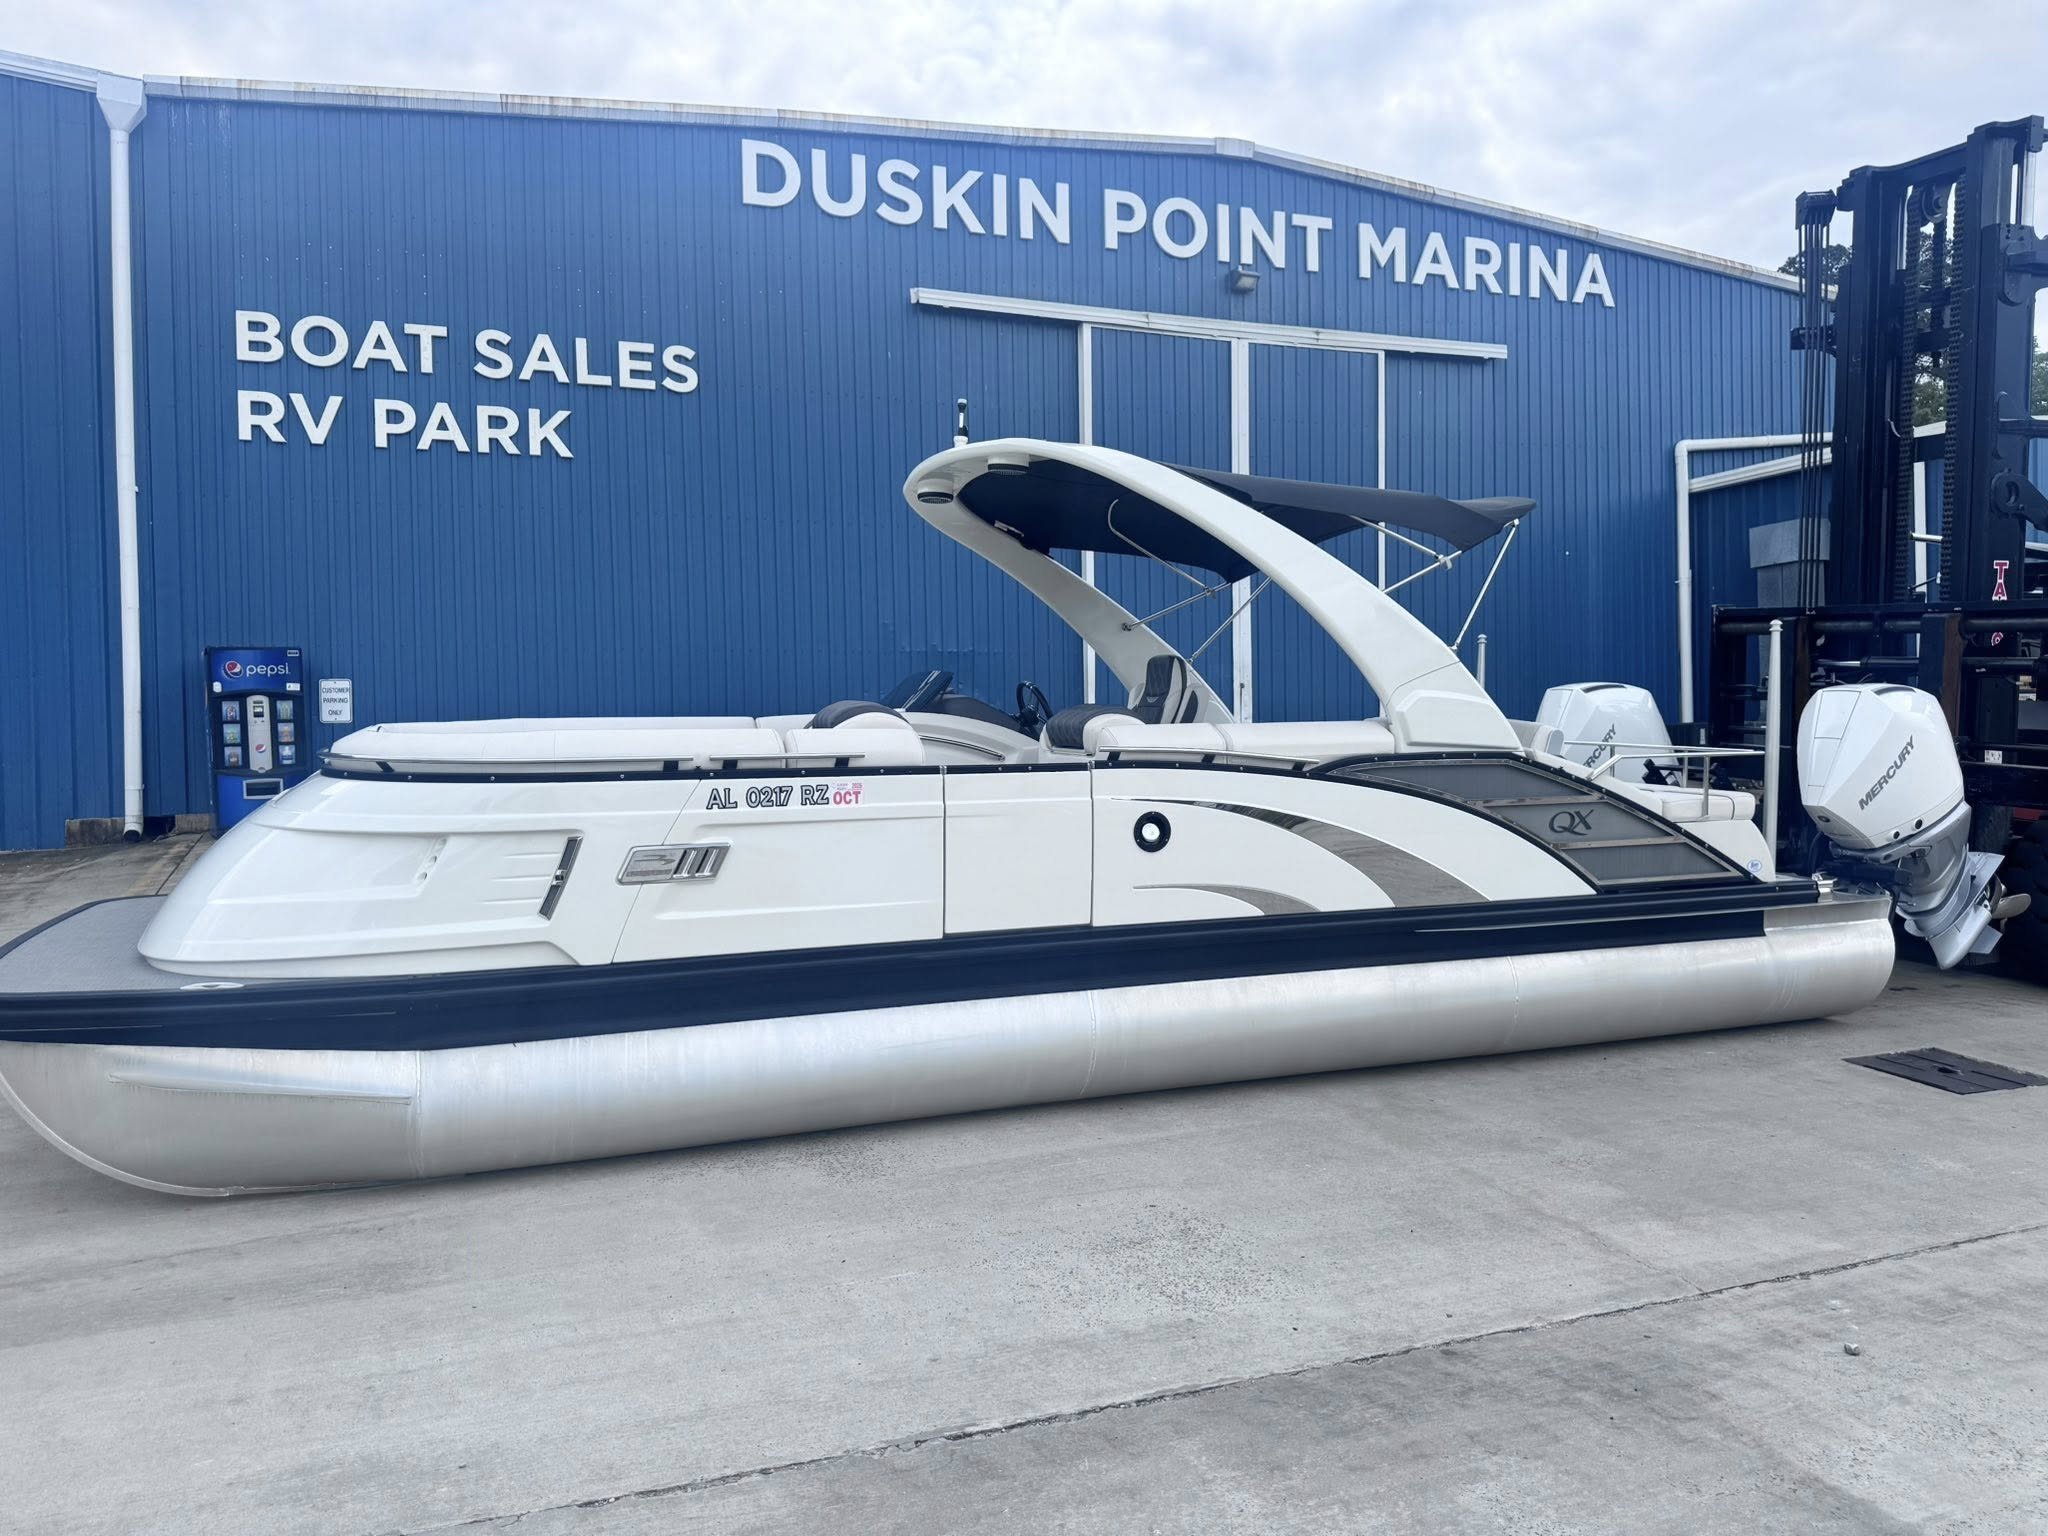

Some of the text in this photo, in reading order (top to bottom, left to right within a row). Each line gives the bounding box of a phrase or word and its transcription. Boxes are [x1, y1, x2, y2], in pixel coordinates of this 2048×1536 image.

[741, 139, 1616, 308] DUSKIN POINT MARINA
[235, 309, 699, 394] BOAT SALES
[237, 389, 574, 458] RV PARK
[246, 663, 289, 677] pepsi
[1858, 734, 1914, 810] MERCURY
[706, 784, 829, 809] AL 0217 RZ
[833, 790, 861, 805] OCT
[1549, 809, 1594, 836] QX
